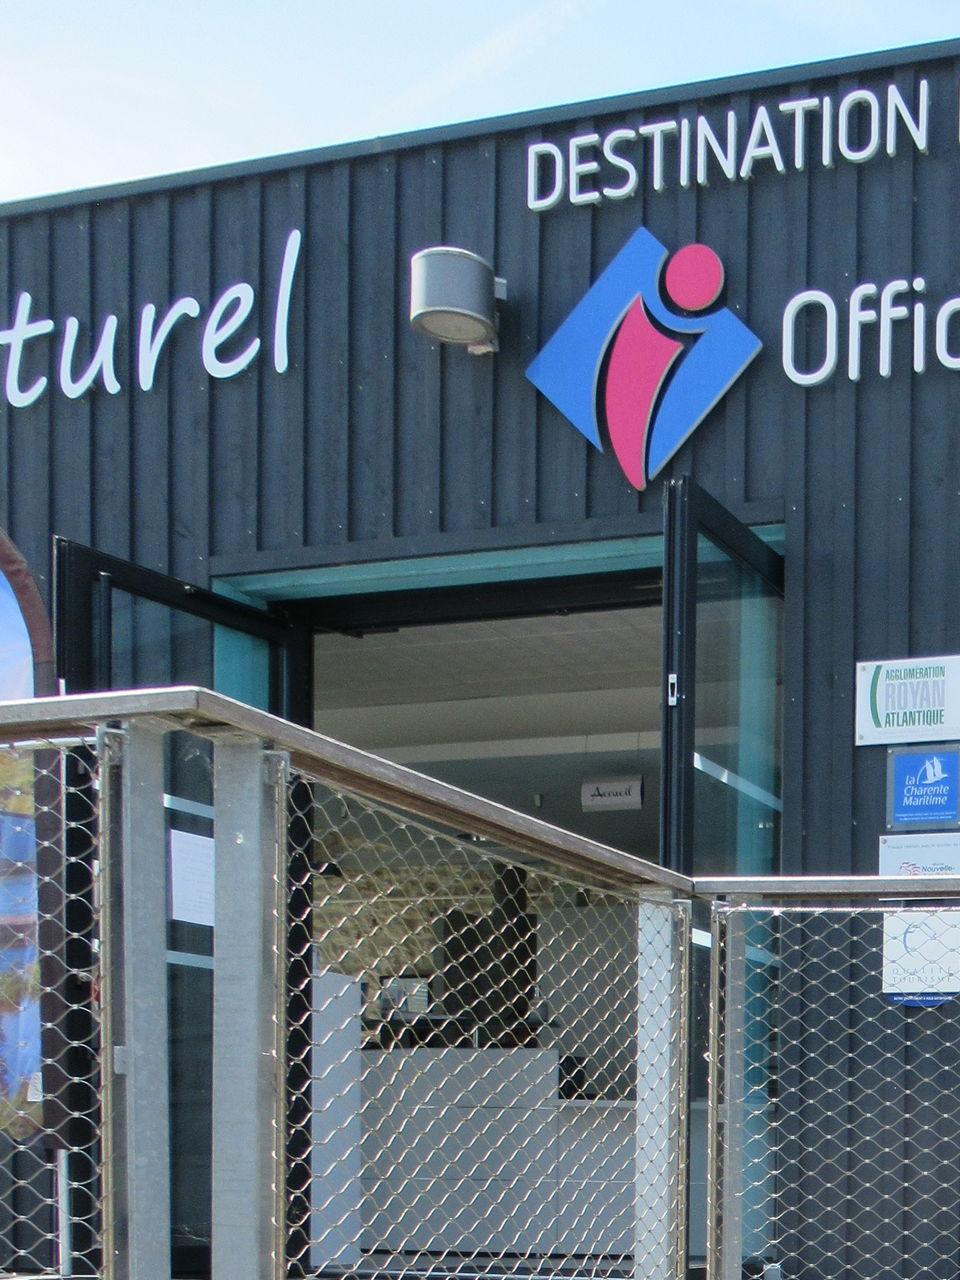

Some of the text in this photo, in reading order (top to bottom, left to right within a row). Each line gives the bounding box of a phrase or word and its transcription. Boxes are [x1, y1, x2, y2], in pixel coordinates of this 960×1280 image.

[527, 79, 930, 212] DESTINATION
[885, 679, 945, 711] ROYAN
[885, 709, 944, 728] ATLANTIQUE
[903, 784, 950, 796] Charente
[902, 795, 948, 807] Maritime
